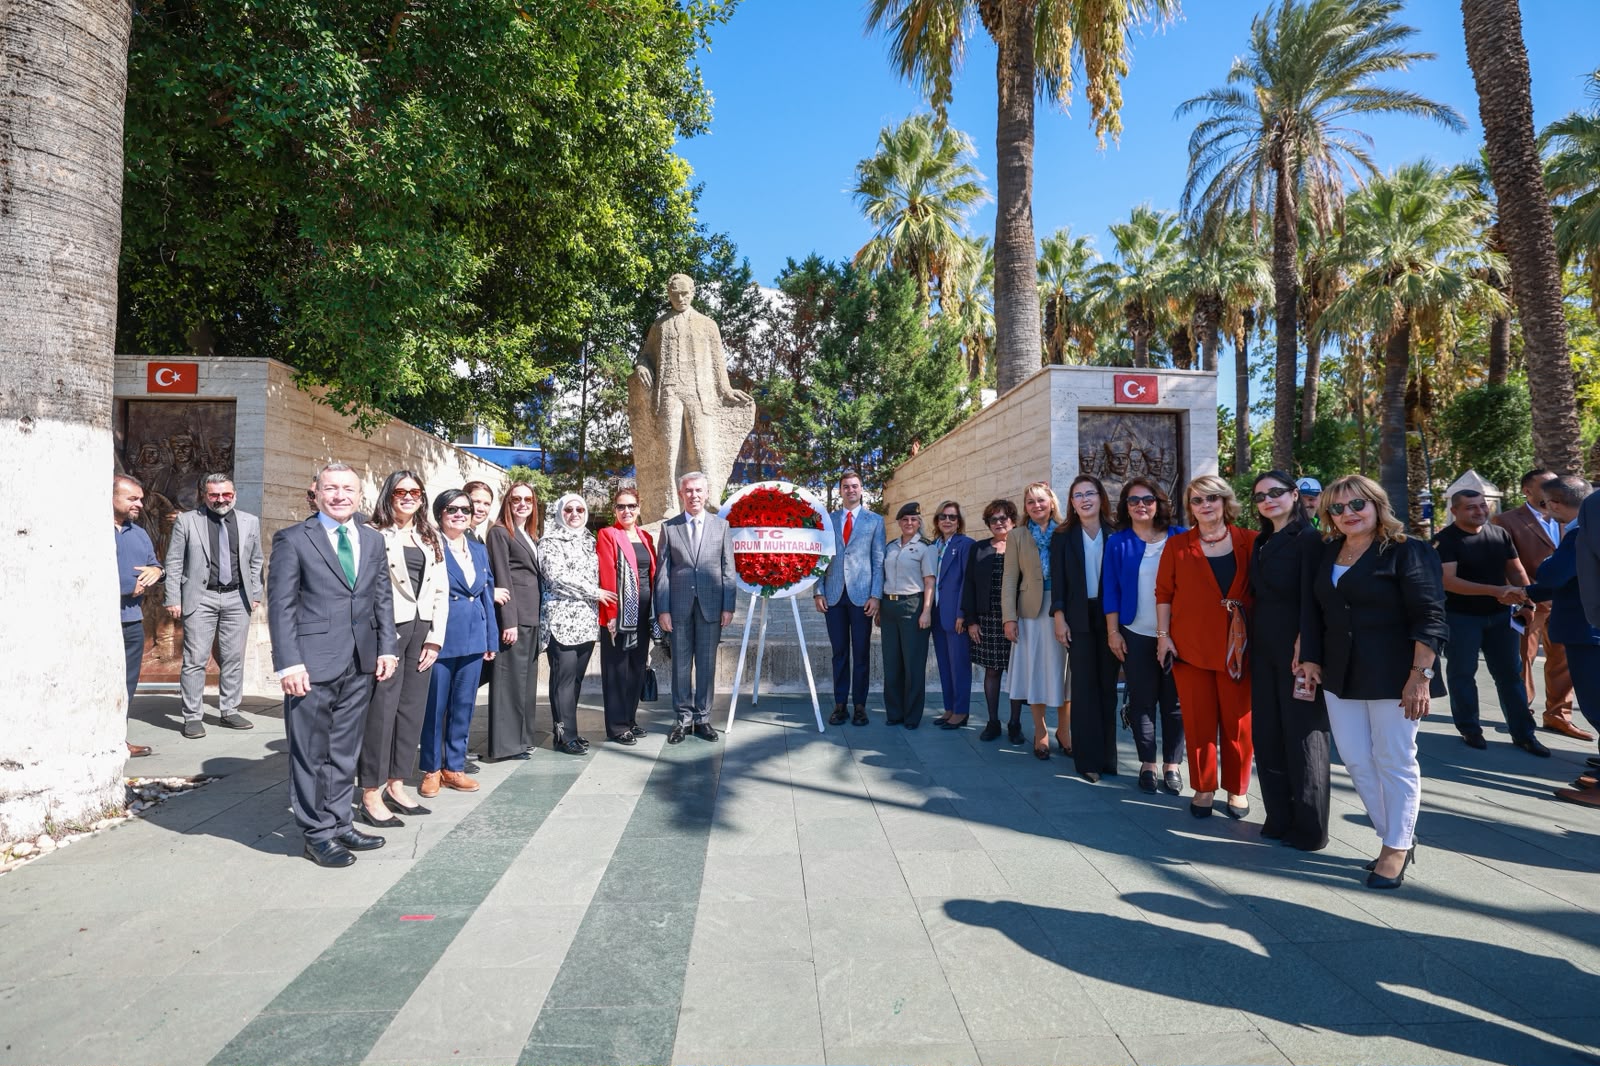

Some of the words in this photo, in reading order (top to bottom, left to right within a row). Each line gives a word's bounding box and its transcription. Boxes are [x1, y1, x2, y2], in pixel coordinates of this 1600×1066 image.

[754, 529, 784, 539] TC
[733, 540, 761, 551] DRUM
[763, 540, 822, 552] MUHTARLARI
